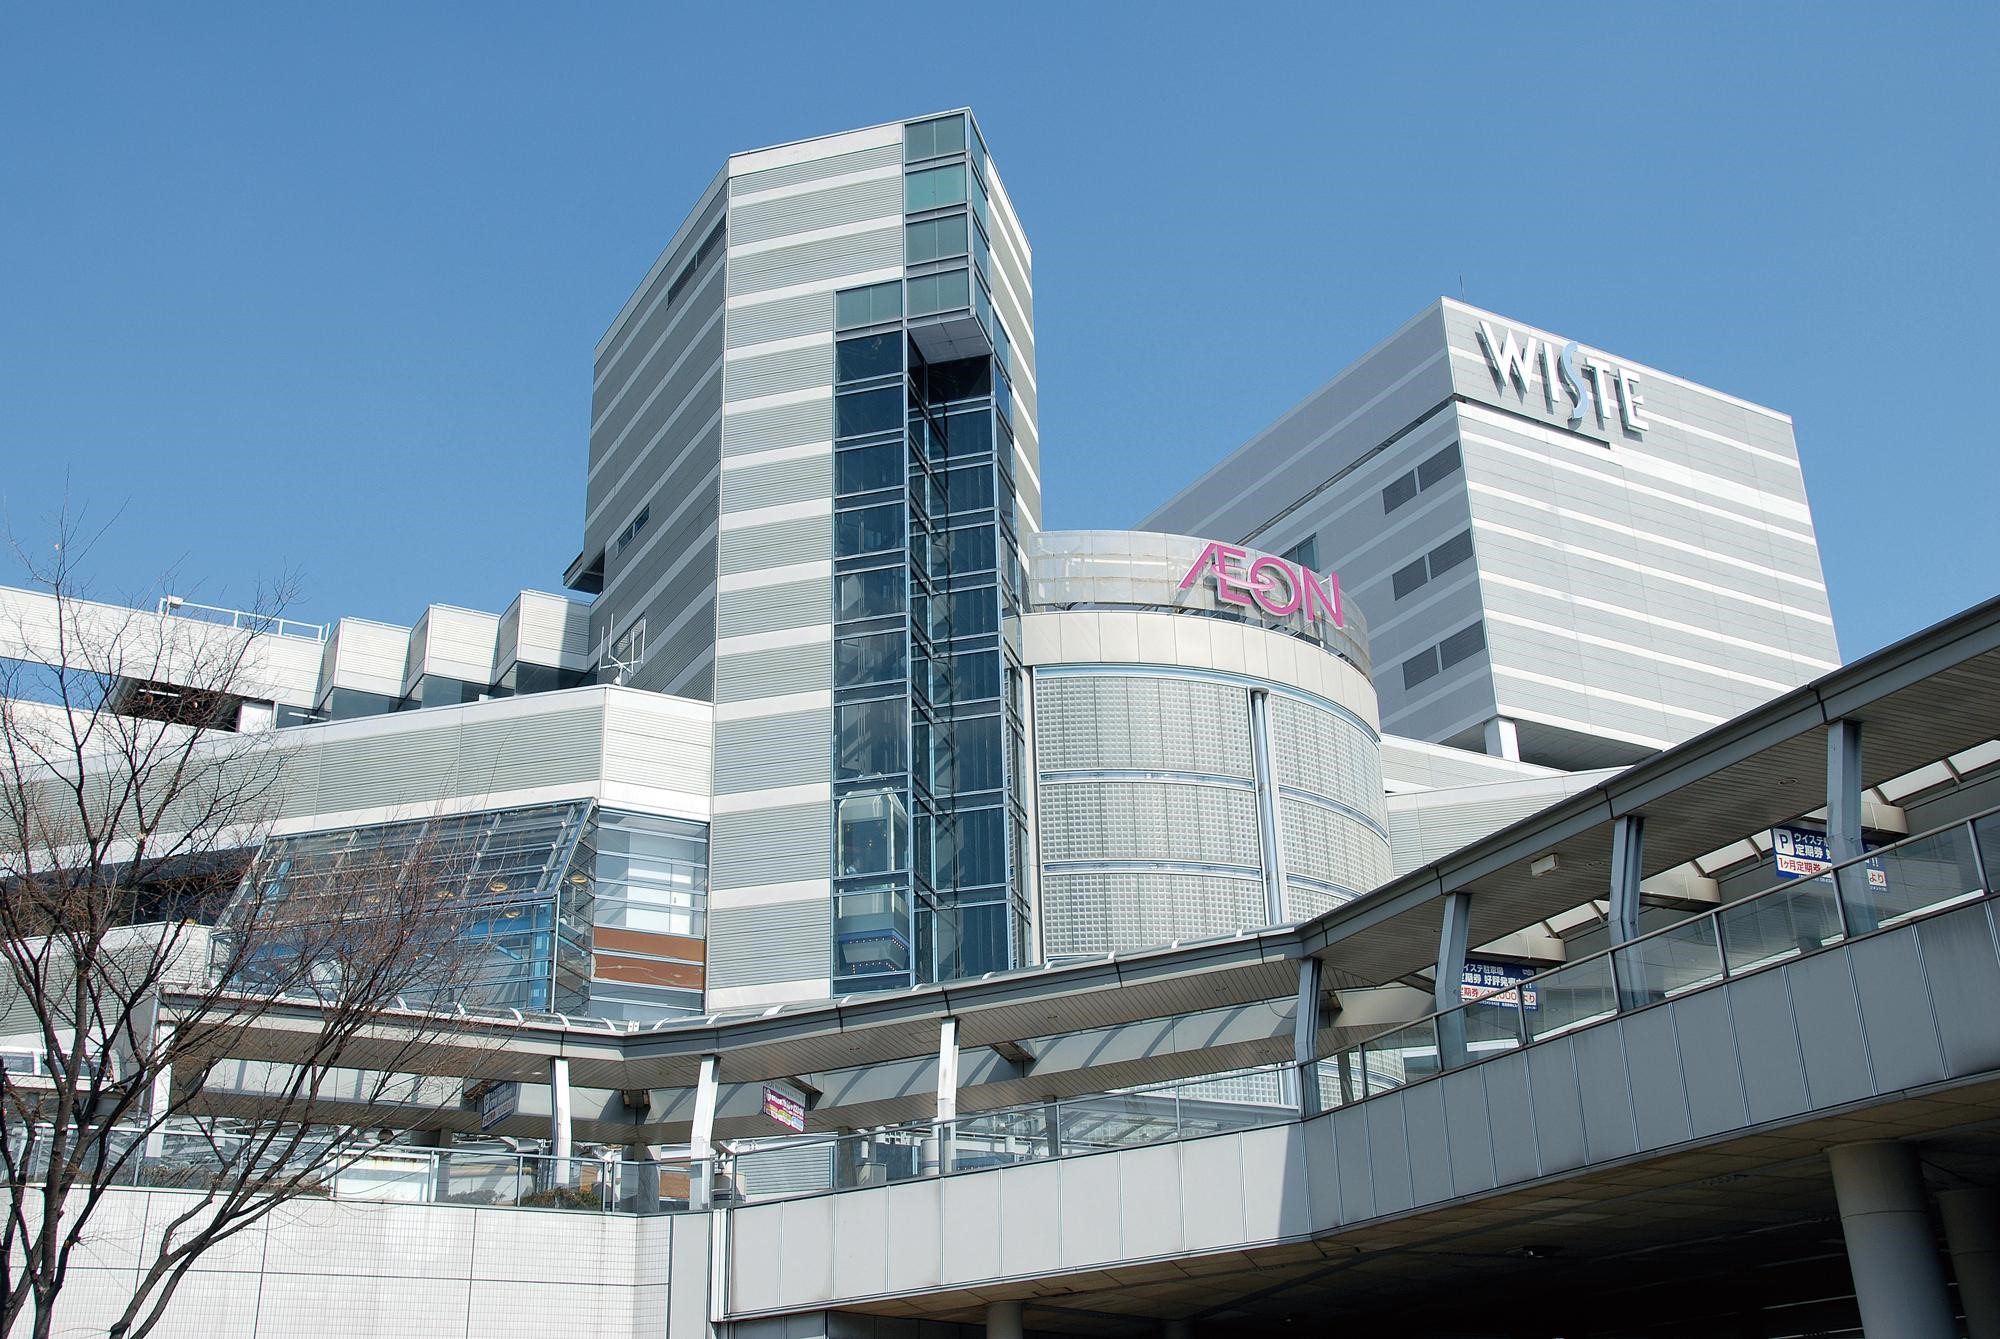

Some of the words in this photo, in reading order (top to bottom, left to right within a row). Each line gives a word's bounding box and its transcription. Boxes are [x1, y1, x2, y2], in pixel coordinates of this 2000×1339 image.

[1479, 320, 1649, 431] WISTE
[1779, 833, 1789, 849] P
[1795, 844, 1824, 859] 定期券
